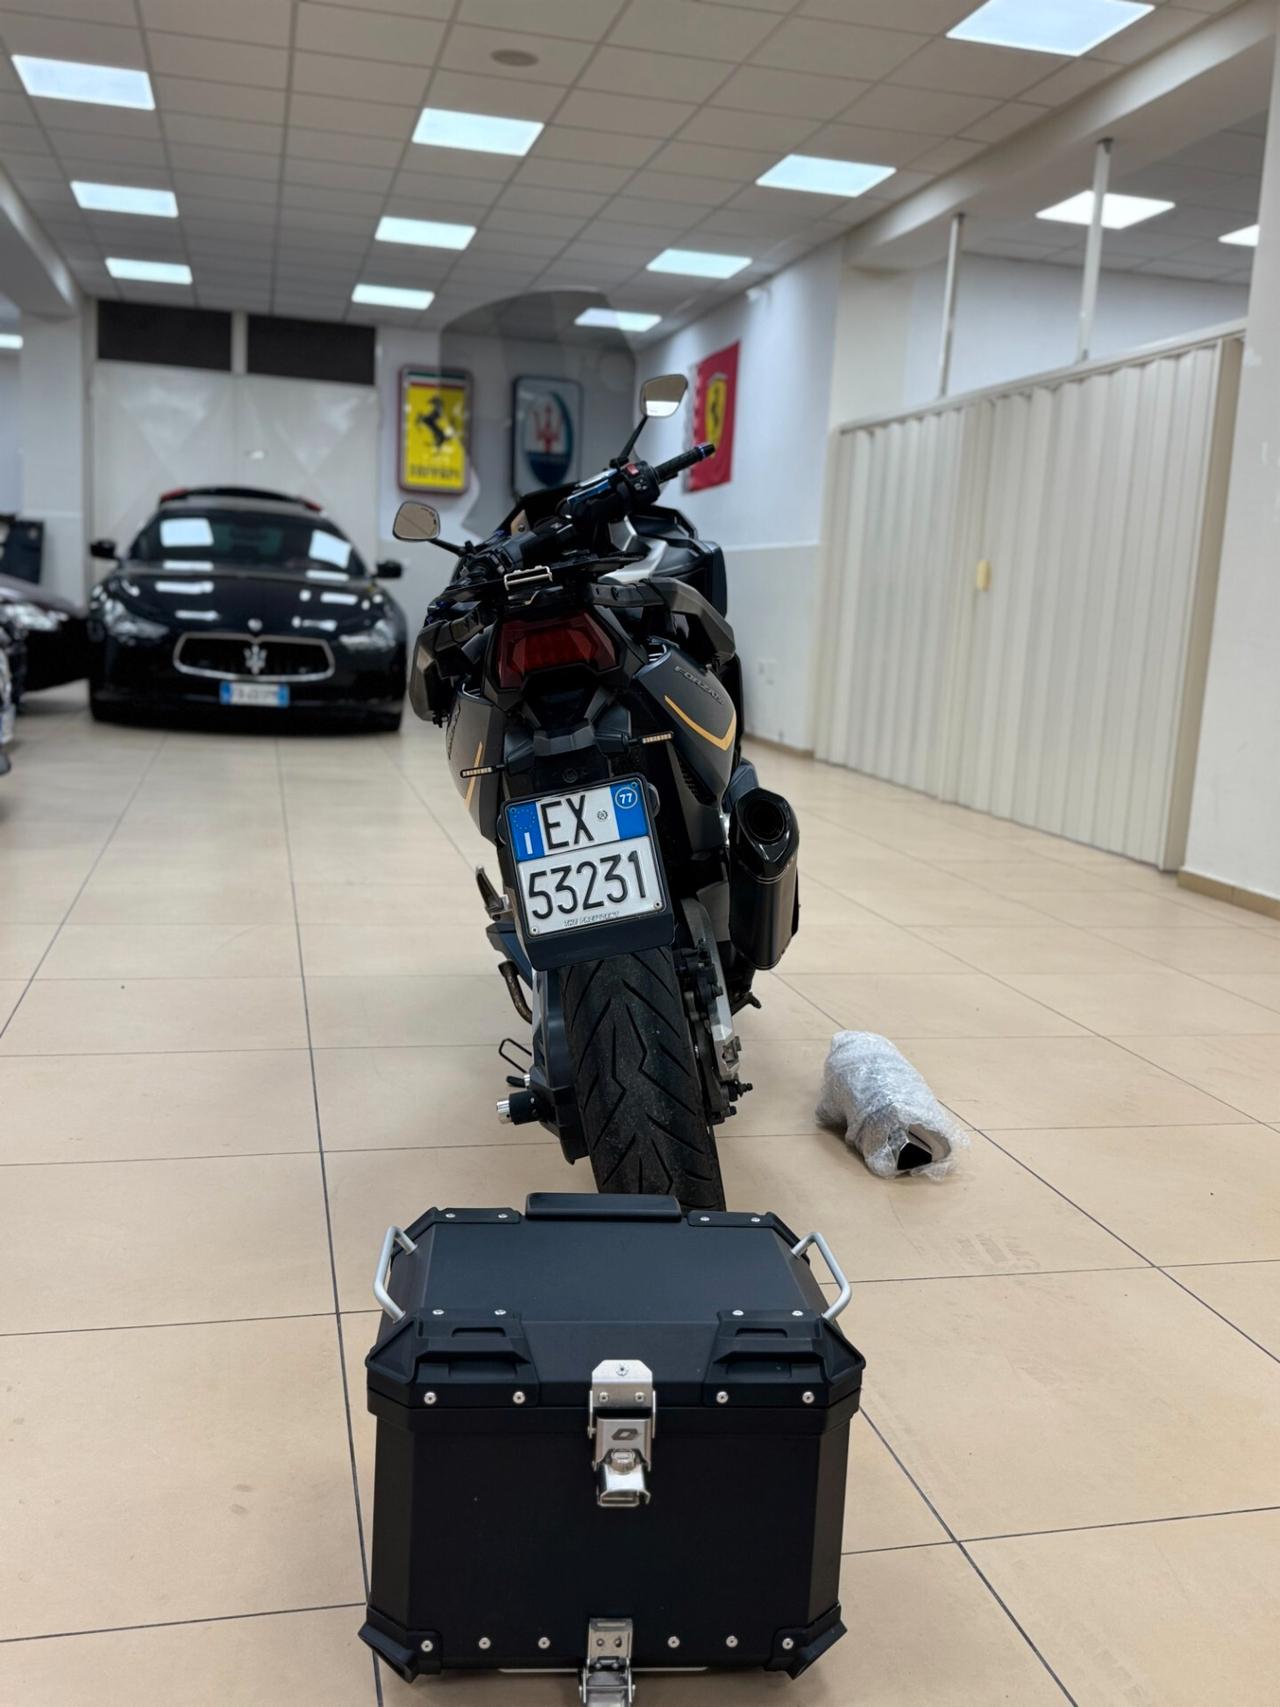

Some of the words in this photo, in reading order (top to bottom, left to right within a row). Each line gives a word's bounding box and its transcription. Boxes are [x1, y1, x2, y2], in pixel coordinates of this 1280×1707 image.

[619, 792, 634, 805] 77
[540, 794, 595, 851] EX
[523, 831, 533, 855] I
[528, 850, 647, 920] 53231
